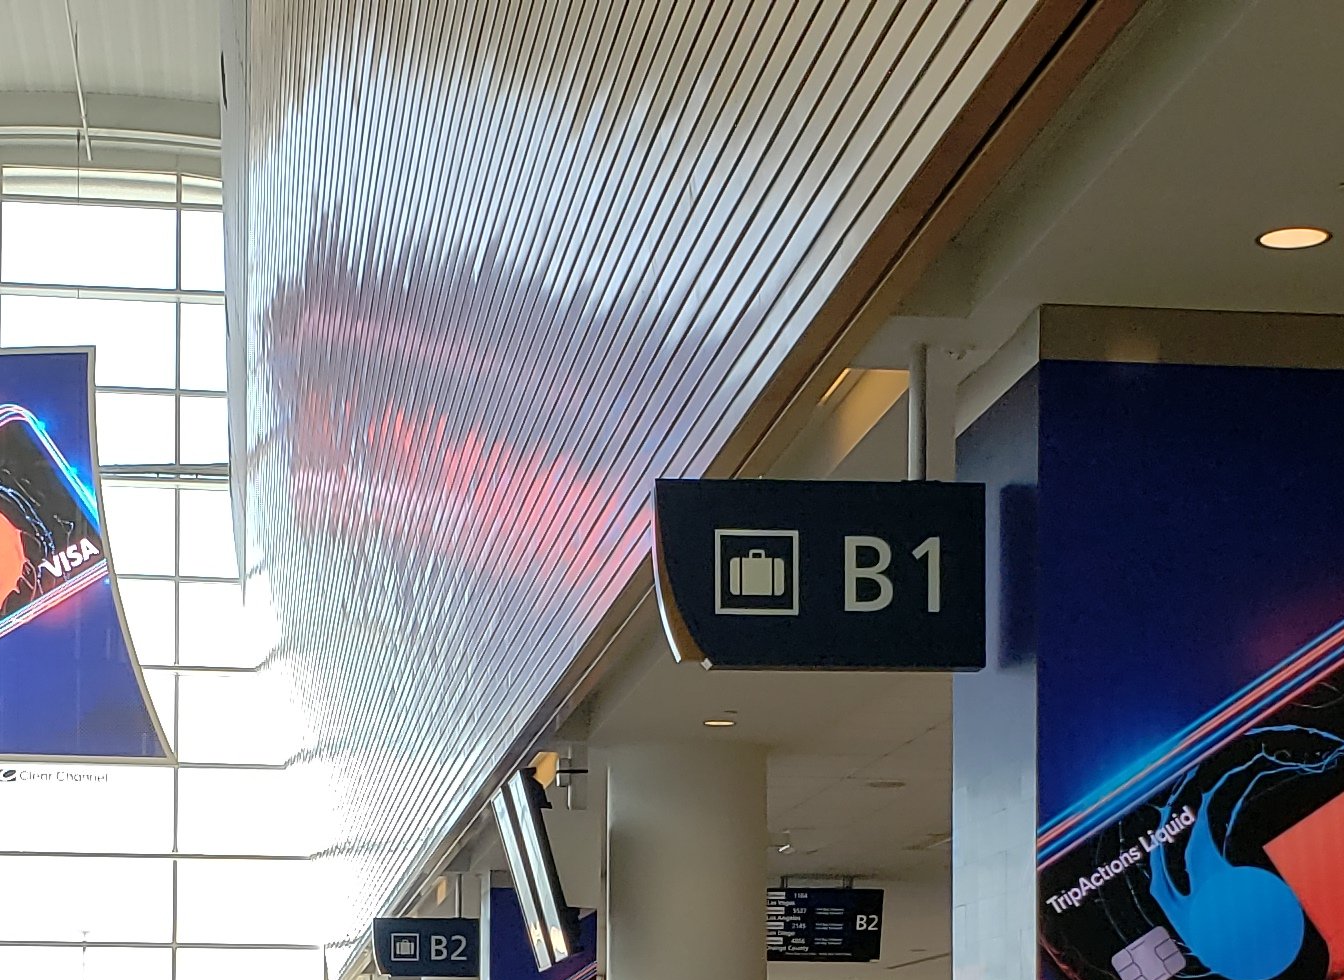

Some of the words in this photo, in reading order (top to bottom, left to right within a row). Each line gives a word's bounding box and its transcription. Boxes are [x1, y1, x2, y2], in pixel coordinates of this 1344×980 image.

[42, 537, 99, 577] VISA
[844, 535, 941, 613] B1
[1046, 845, 1142, 914] TripActions
[1138, 805, 1196, 853] Liquid
[856, 914, 879, 931] B2
[430, 935, 467, 961] B2
